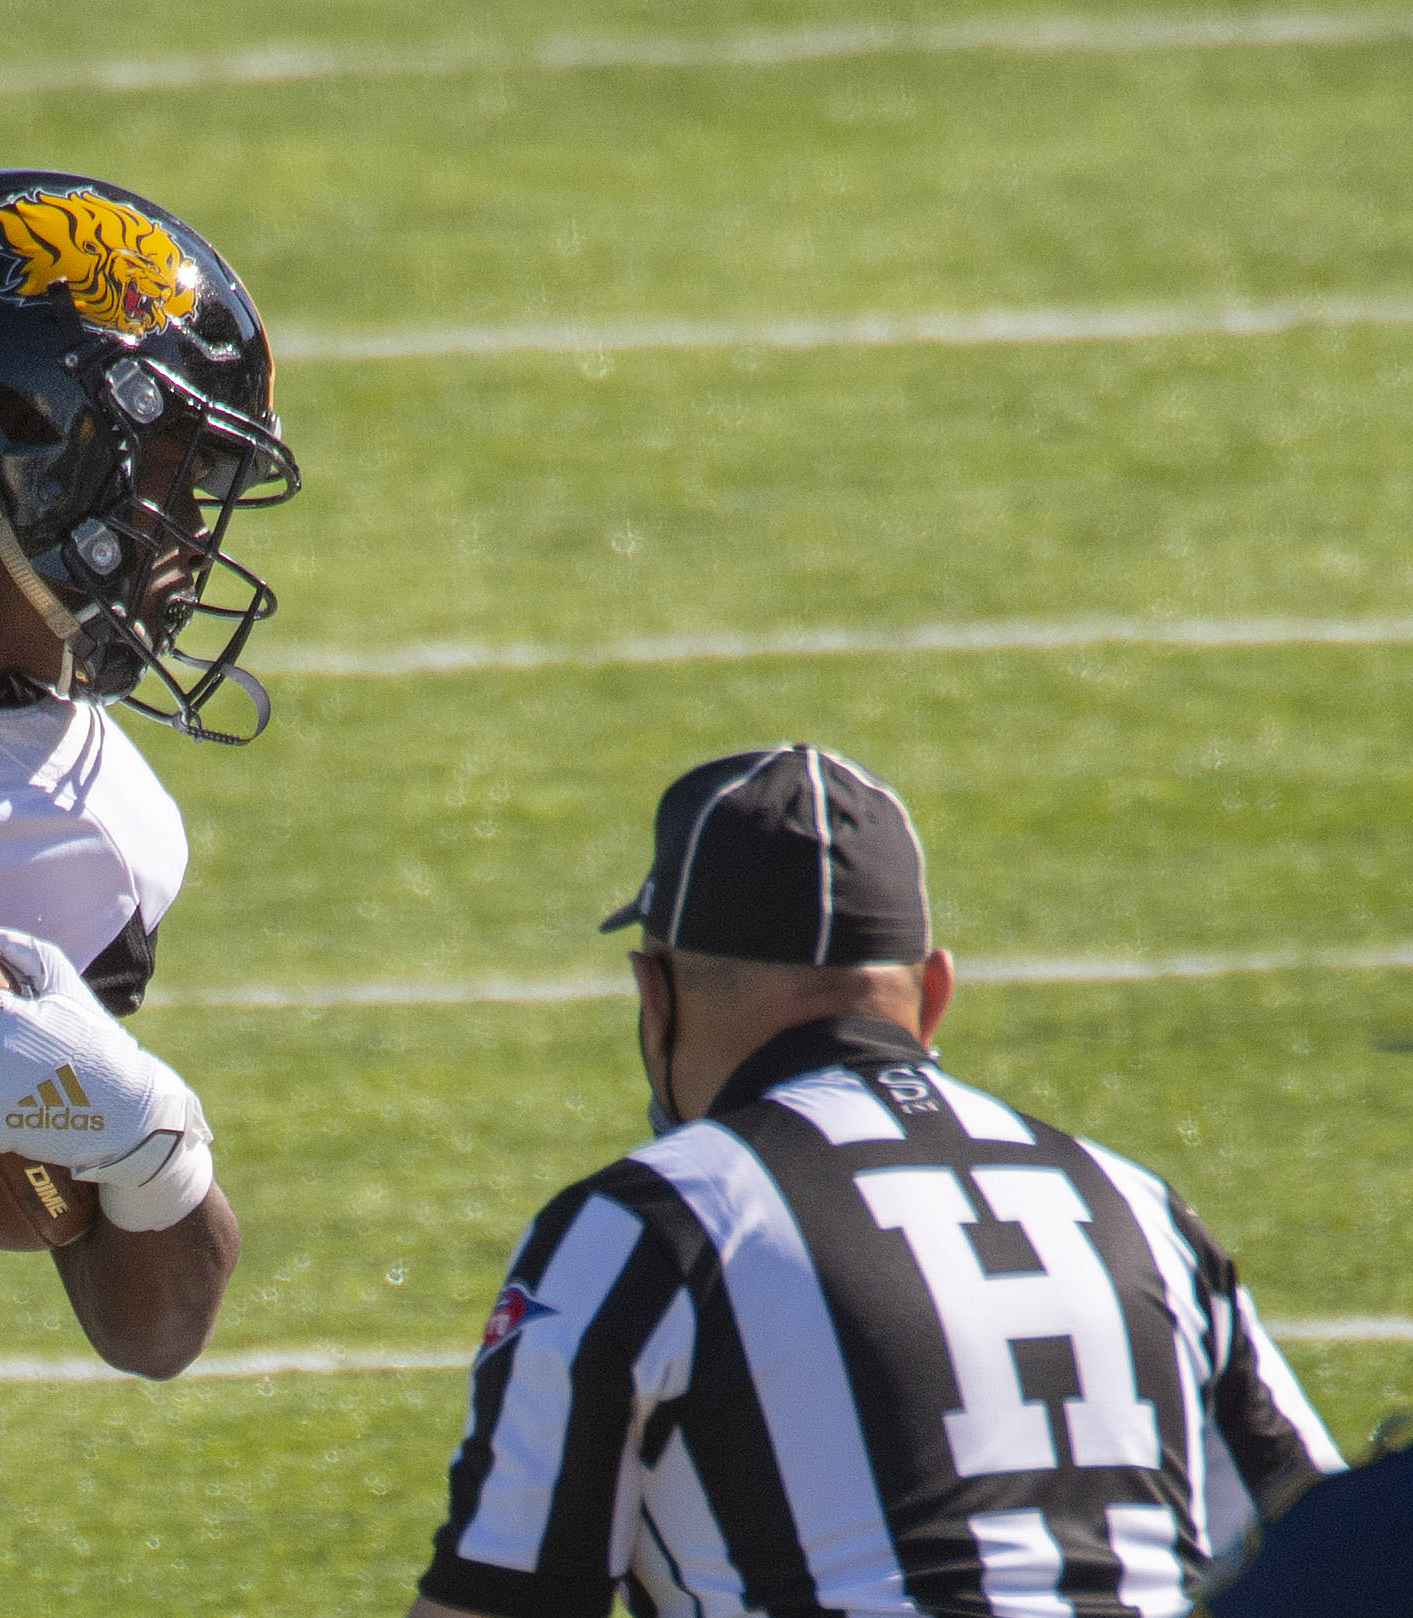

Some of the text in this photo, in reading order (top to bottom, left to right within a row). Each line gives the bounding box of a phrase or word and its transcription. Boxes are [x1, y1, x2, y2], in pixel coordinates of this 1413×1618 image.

[5, 1106, 105, 1132] adidas
[24, 1164, 70, 1220] DIME
[852, 1163, 1162, 1478] H
